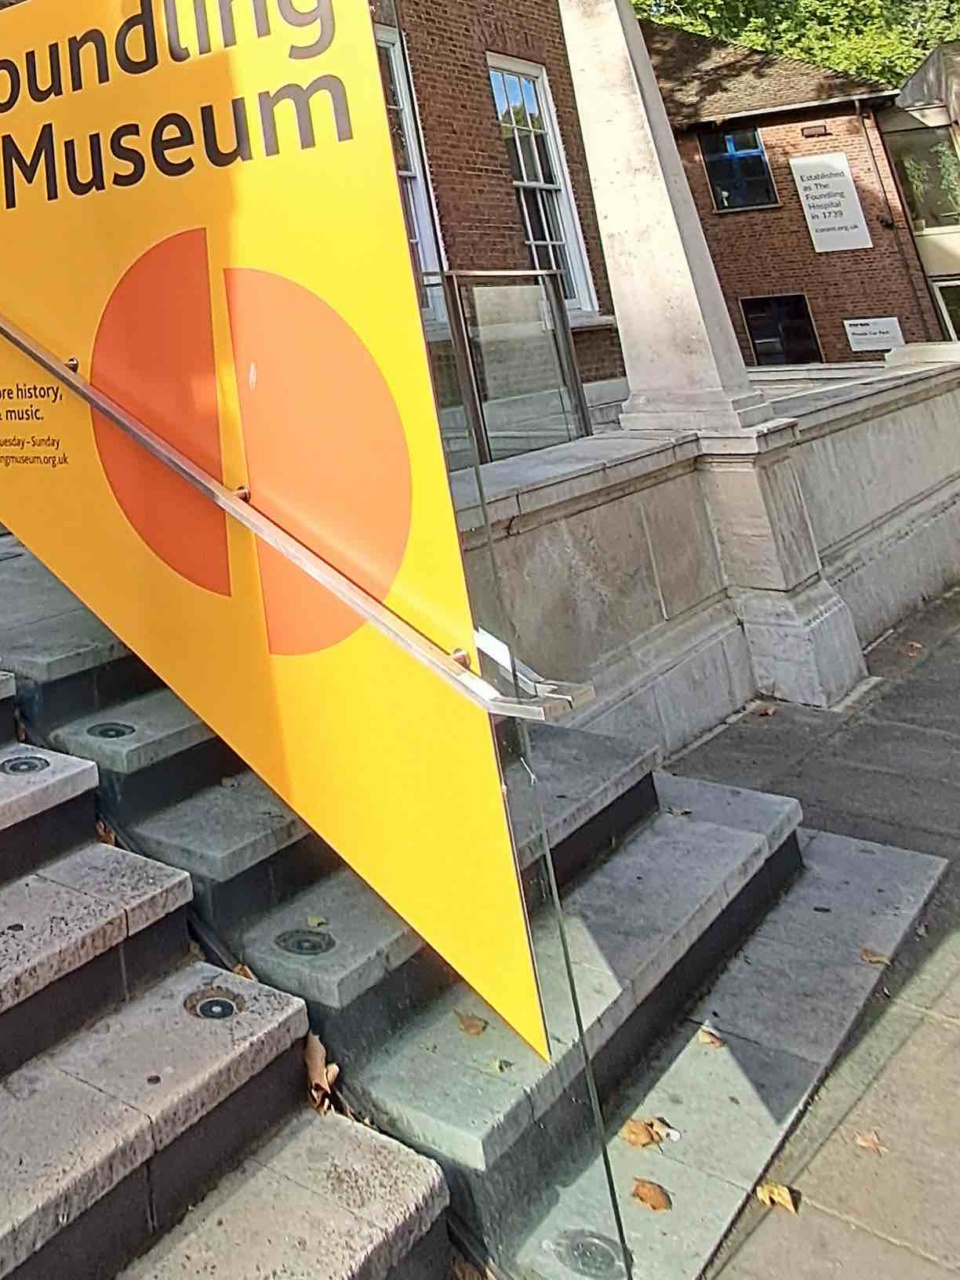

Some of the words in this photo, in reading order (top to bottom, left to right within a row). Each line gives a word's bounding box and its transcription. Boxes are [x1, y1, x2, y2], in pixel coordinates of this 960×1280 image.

[1, 74, 353, 209] Museum
[800, 171, 845, 182] Established
[814, 182, 830, 190] The
[805, 192, 846, 200] Foundling
[808, 201, 841, 210] Hospital
[16, 383, 63, 403] history,
[5, 404, 44, 421] music.
